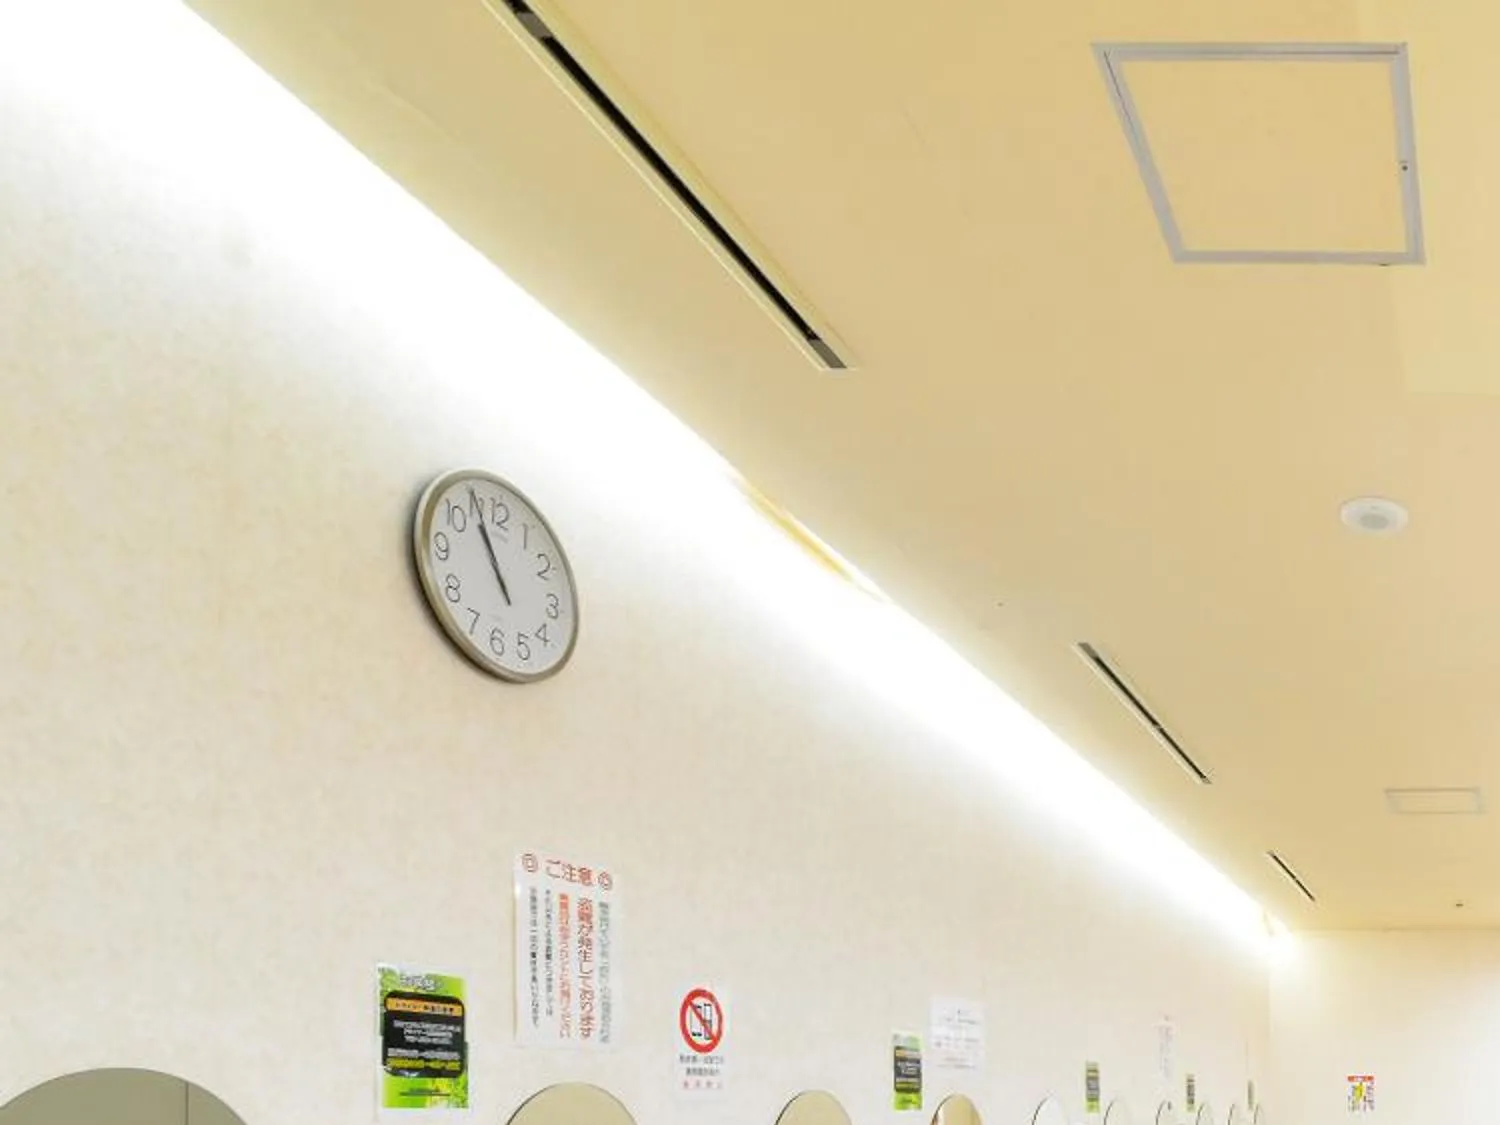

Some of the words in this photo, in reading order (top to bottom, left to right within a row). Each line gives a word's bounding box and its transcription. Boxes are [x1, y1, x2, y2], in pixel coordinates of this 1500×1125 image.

[446, 498, 467, 533] 10
[490, 497, 509, 531] 12
[434, 531, 449, 561] 9
[521, 523, 530, 550] 1
[536, 553, 551, 581] 2
[445, 573, 461, 603] 8
[546, 593, 559, 619] 3
[467, 607, 481, 635] 7
[535, 623, 550, 647] 4
[490, 628, 505, 656] 6
[517, 633, 531, 660] 5
[546, 859, 594, 887] ご注意
